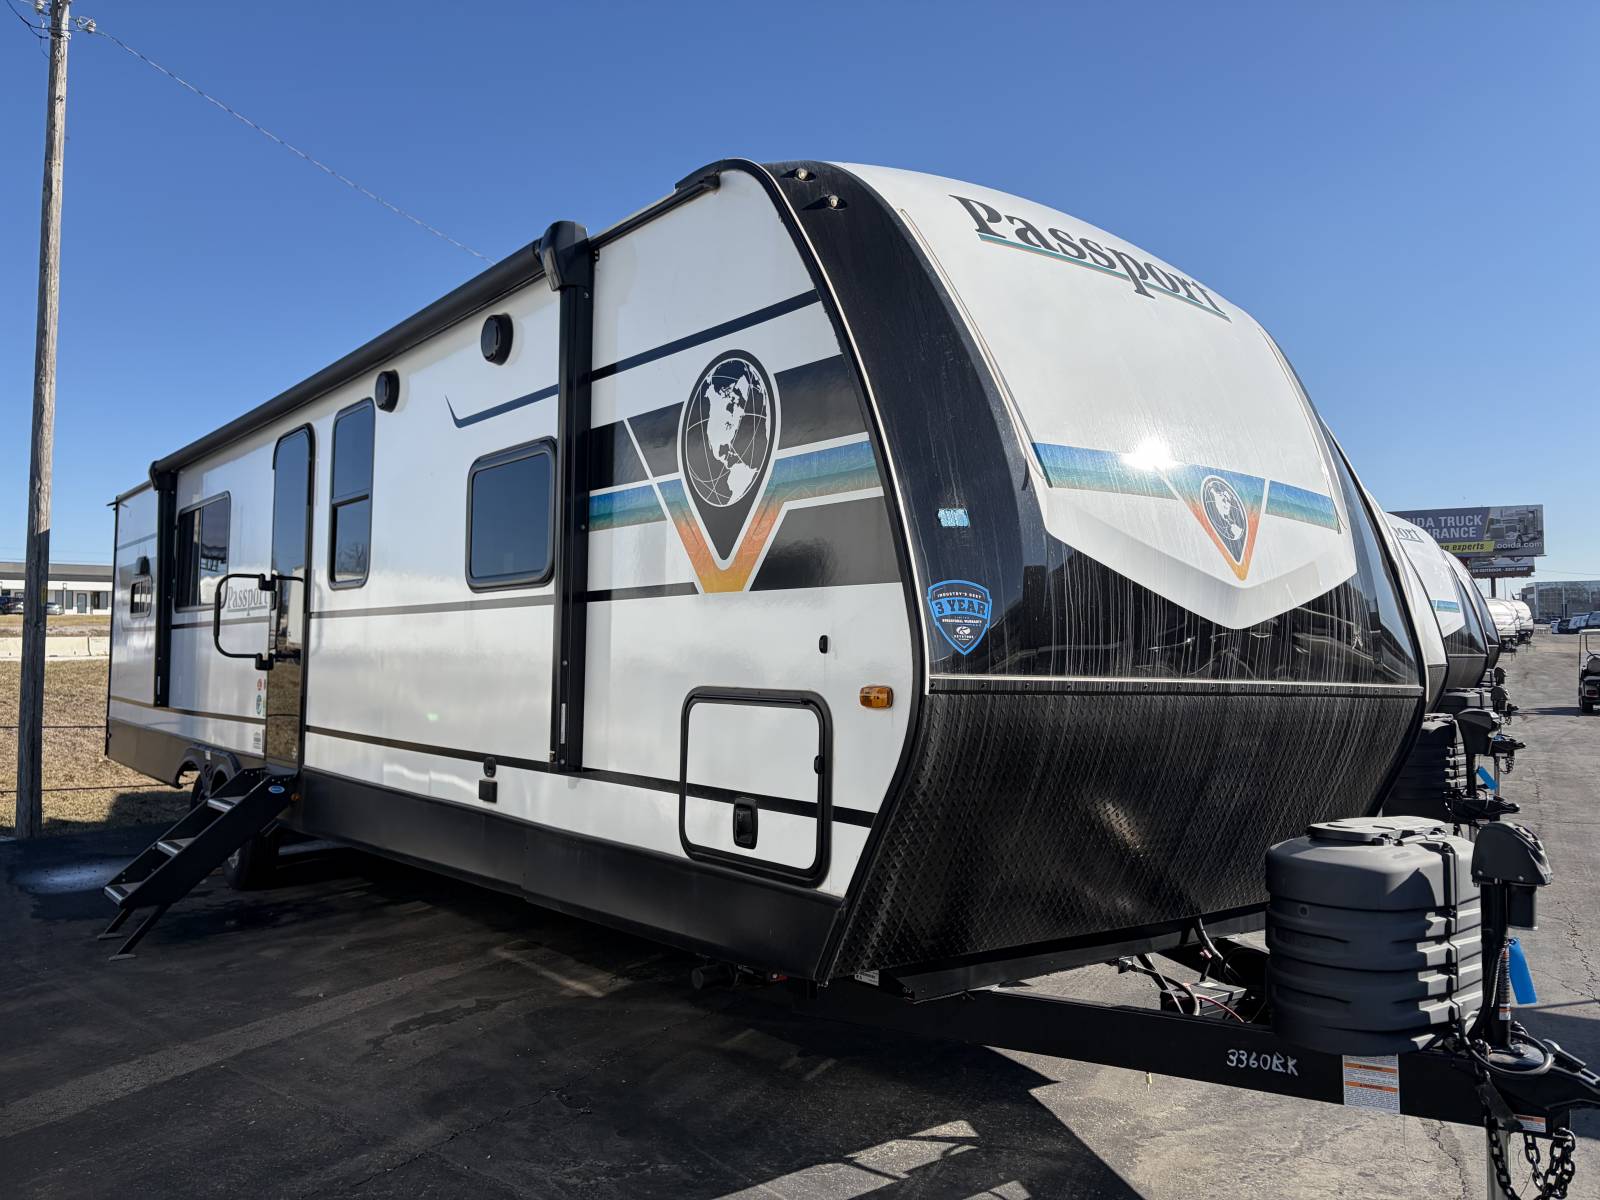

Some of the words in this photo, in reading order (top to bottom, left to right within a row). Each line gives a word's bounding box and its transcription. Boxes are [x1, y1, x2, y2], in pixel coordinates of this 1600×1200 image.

[948, 194, 1226, 315] Passport
[1438, 514, 1482, 528] TRUCK
[1452, 543, 1485, 552] experts
[1496, 541, 1543, 549] ooida.com
[227, 586, 268, 617] Passport
[935, 601, 945, 615] 3
[946, 599, 986, 615] YEAR
